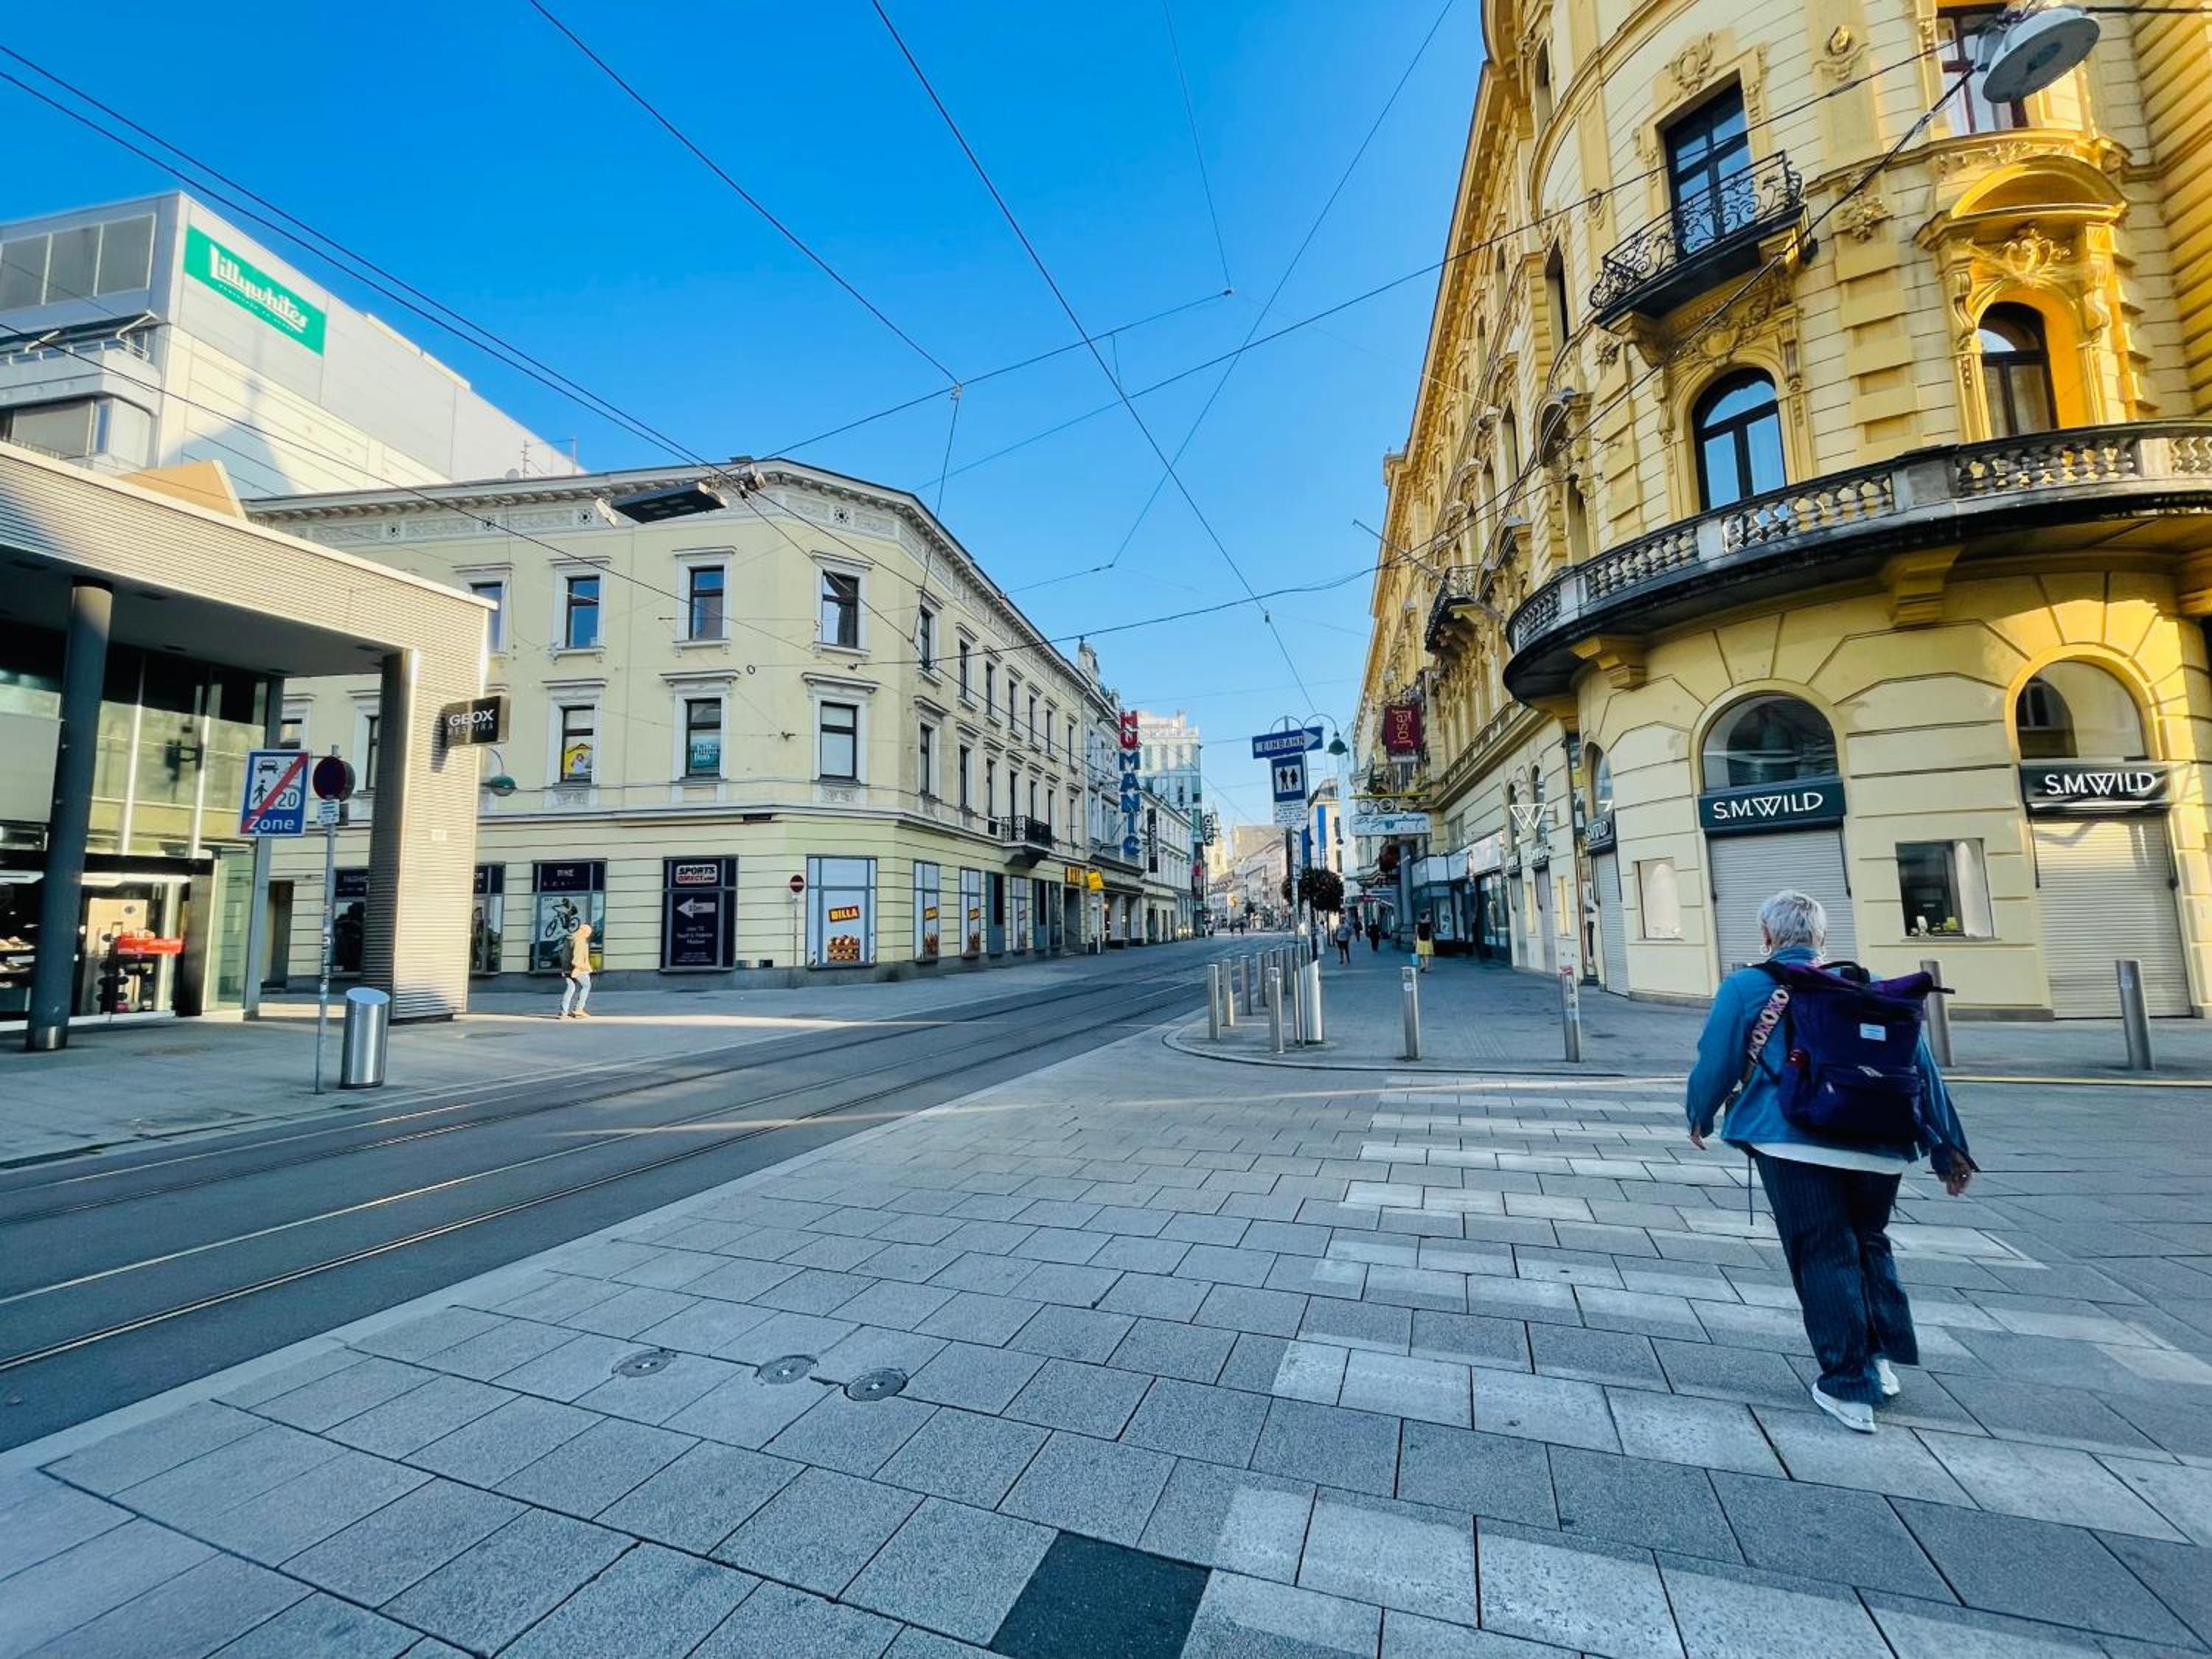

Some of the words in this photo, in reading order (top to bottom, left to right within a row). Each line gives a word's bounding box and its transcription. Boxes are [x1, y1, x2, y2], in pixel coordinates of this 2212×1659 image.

[210, 243, 307, 333] Lillywhites
[449, 709, 495, 726] GEOX
[1119, 710, 1141, 856] HUMANIC
[278, 793, 297, 807] 20
[248, 816, 295, 830] Zone
[678, 866, 715, 874] SPORTS
[830, 908, 858, 920] BILLA
